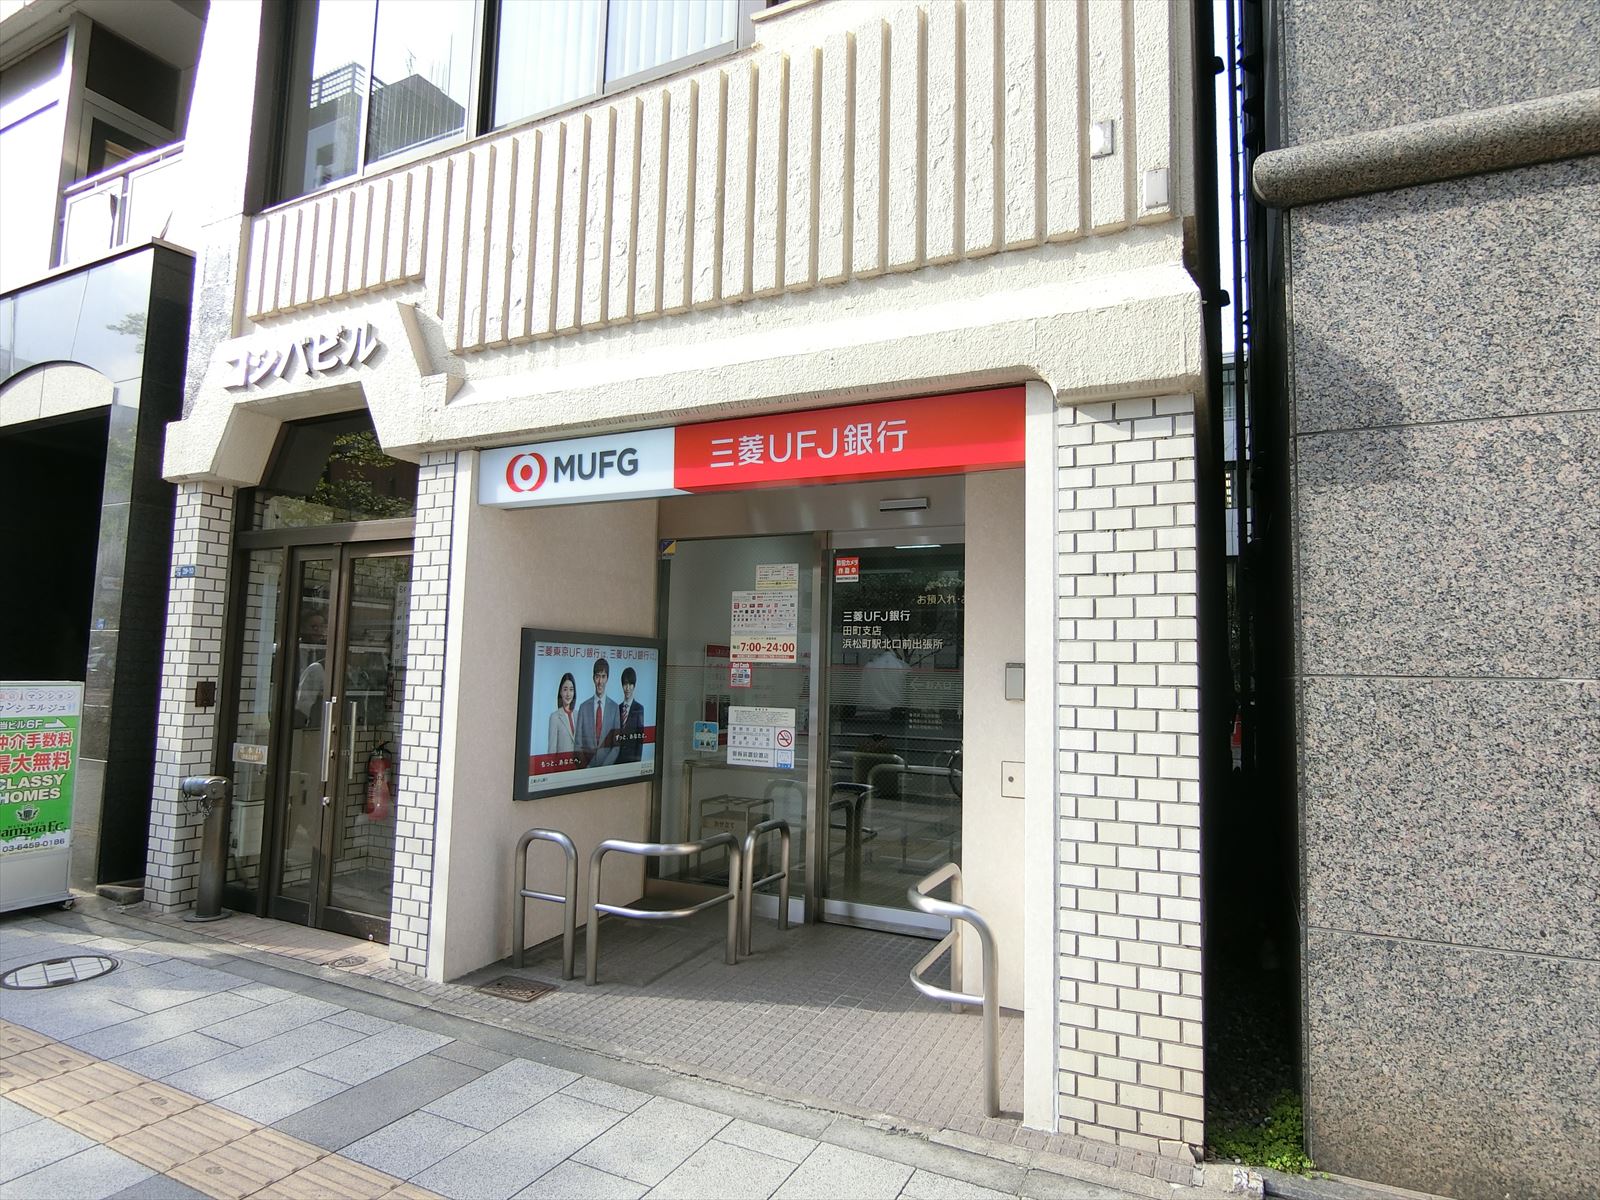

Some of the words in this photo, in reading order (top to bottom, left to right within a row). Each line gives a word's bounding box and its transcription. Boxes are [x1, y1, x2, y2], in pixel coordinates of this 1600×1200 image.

[710, 419, 909, 468] 三菱UFJ銀行
[553, 447, 639, 484] MUFG
[843, 610, 911, 622] 三菱UFJ銀行
[842, 625, 882, 636] 田町支店
[842, 638, 944, 650] 浜松町駅北口前出張所
[2, 838, 65, 853] 03-6459-0186
